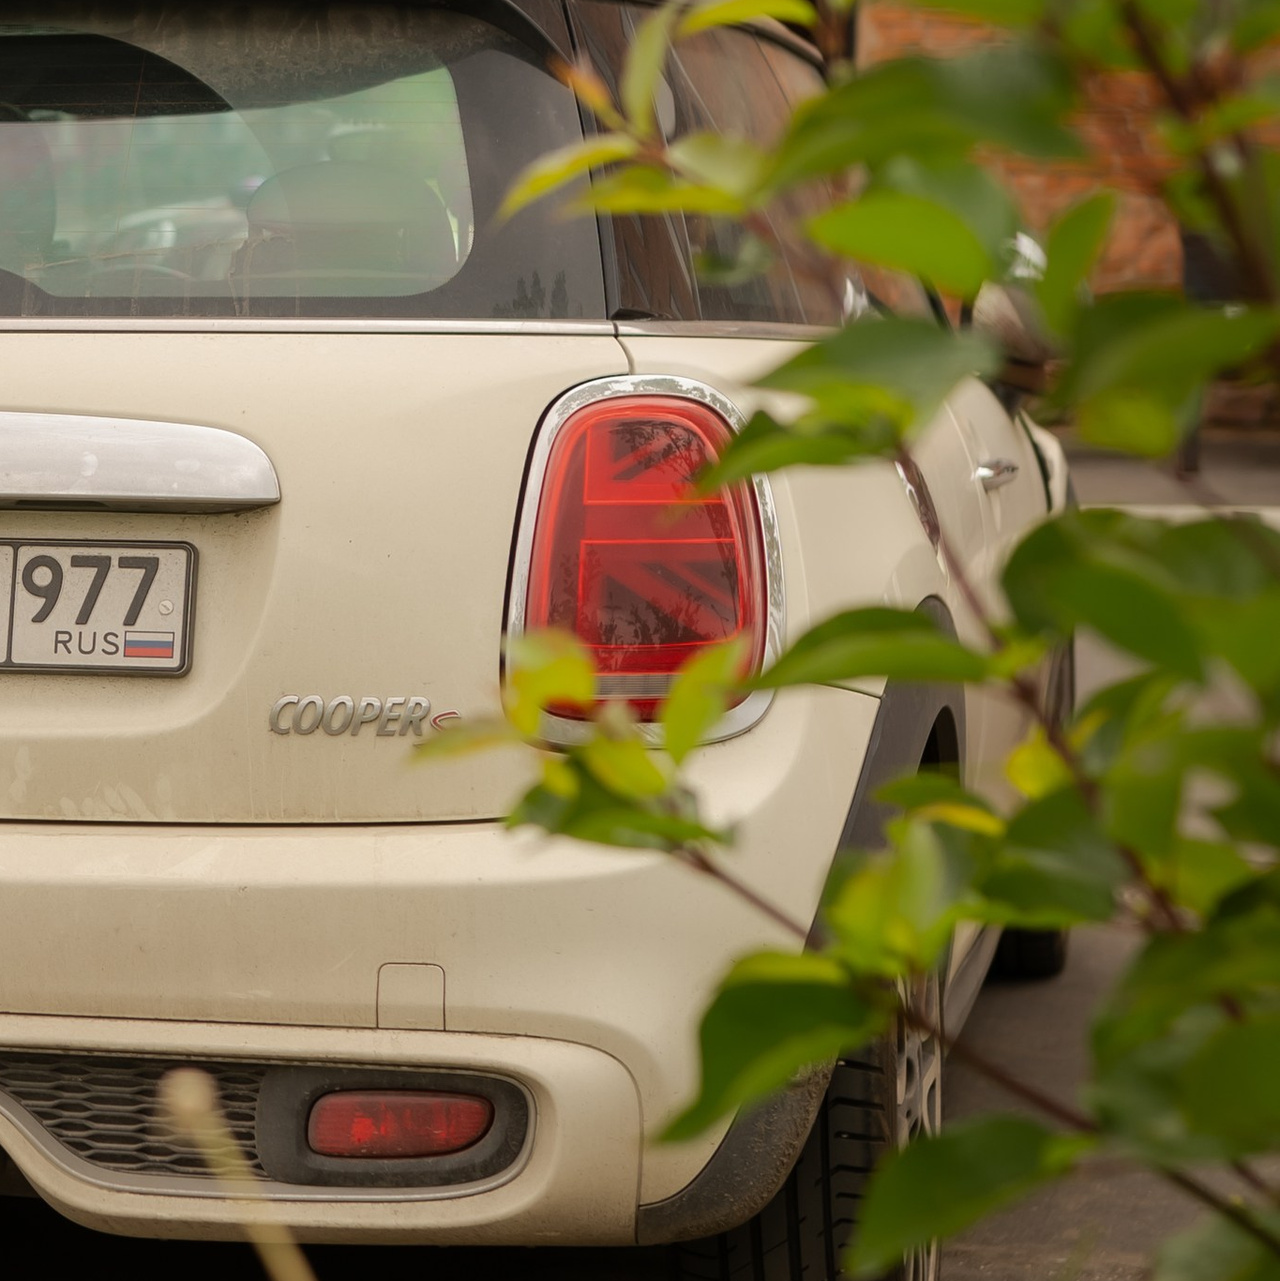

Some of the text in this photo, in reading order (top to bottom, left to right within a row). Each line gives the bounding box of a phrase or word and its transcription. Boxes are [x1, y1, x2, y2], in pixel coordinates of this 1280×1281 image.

[21, 554, 161, 626] 977
[54, 630, 120, 656] RUS
[269, 694, 431, 736] COOPER
